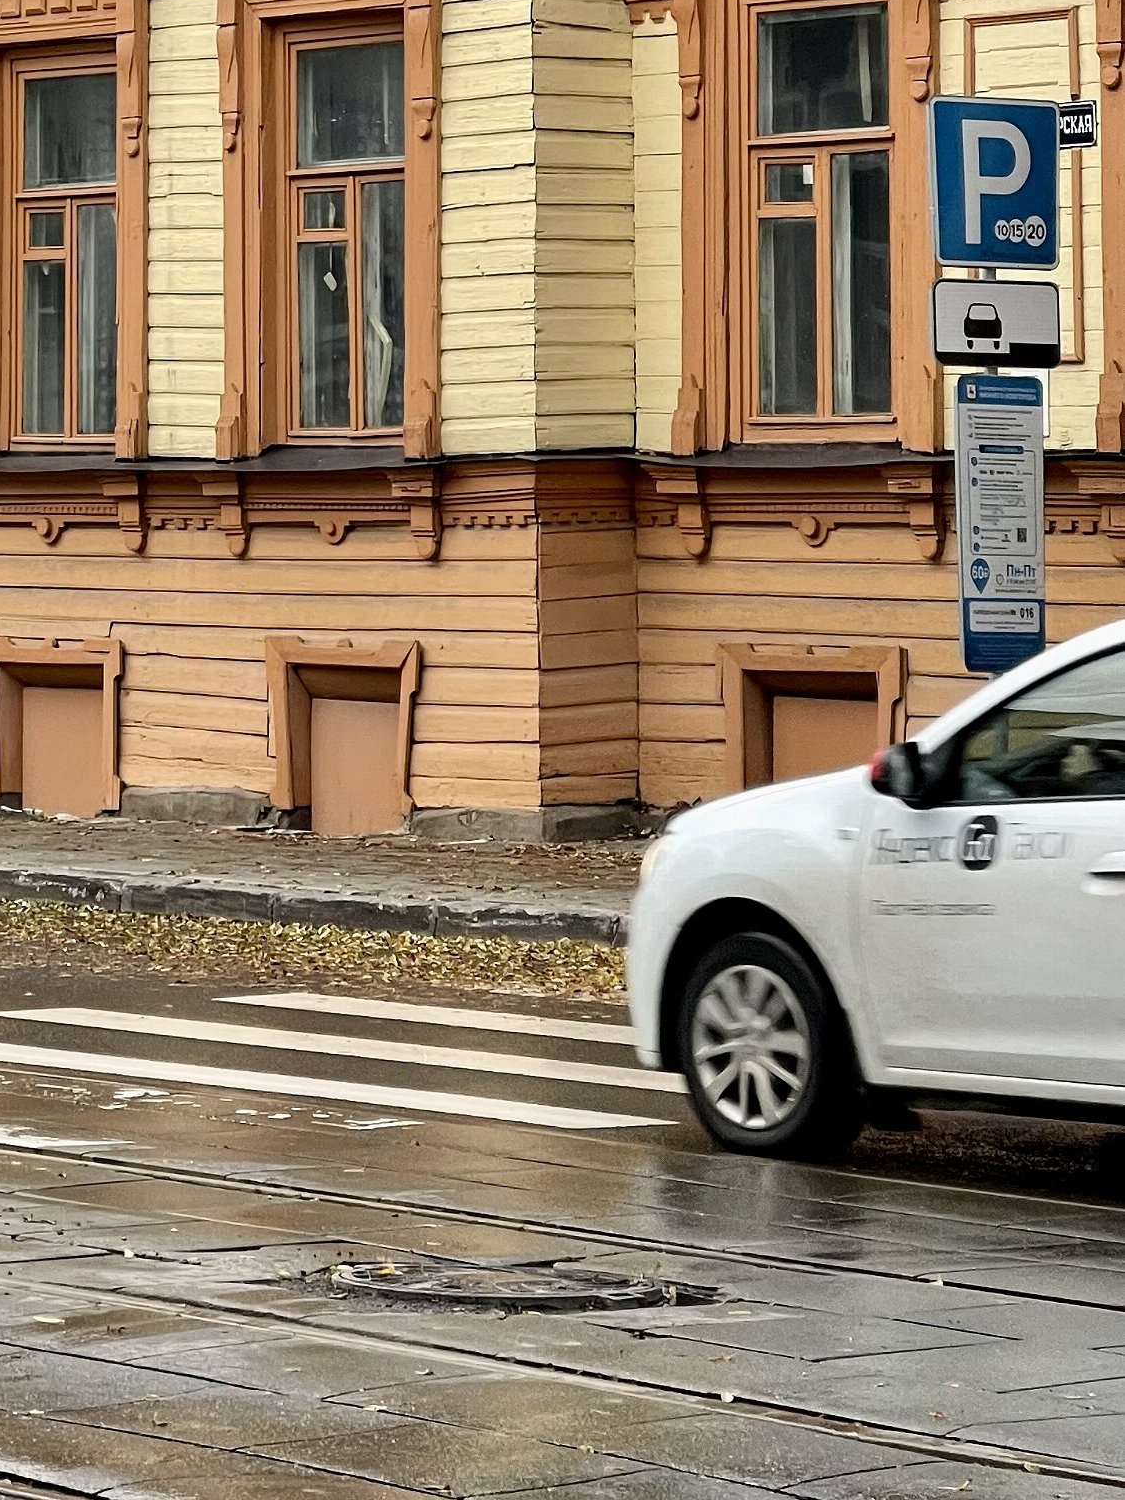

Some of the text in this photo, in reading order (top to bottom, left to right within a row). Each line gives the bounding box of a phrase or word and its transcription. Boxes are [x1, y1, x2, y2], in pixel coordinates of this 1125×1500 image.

[961, 119, 1031, 245] P
[997, 223, 1045, 240] 10 15 20
[1019, 607, 1035, 619] 016
